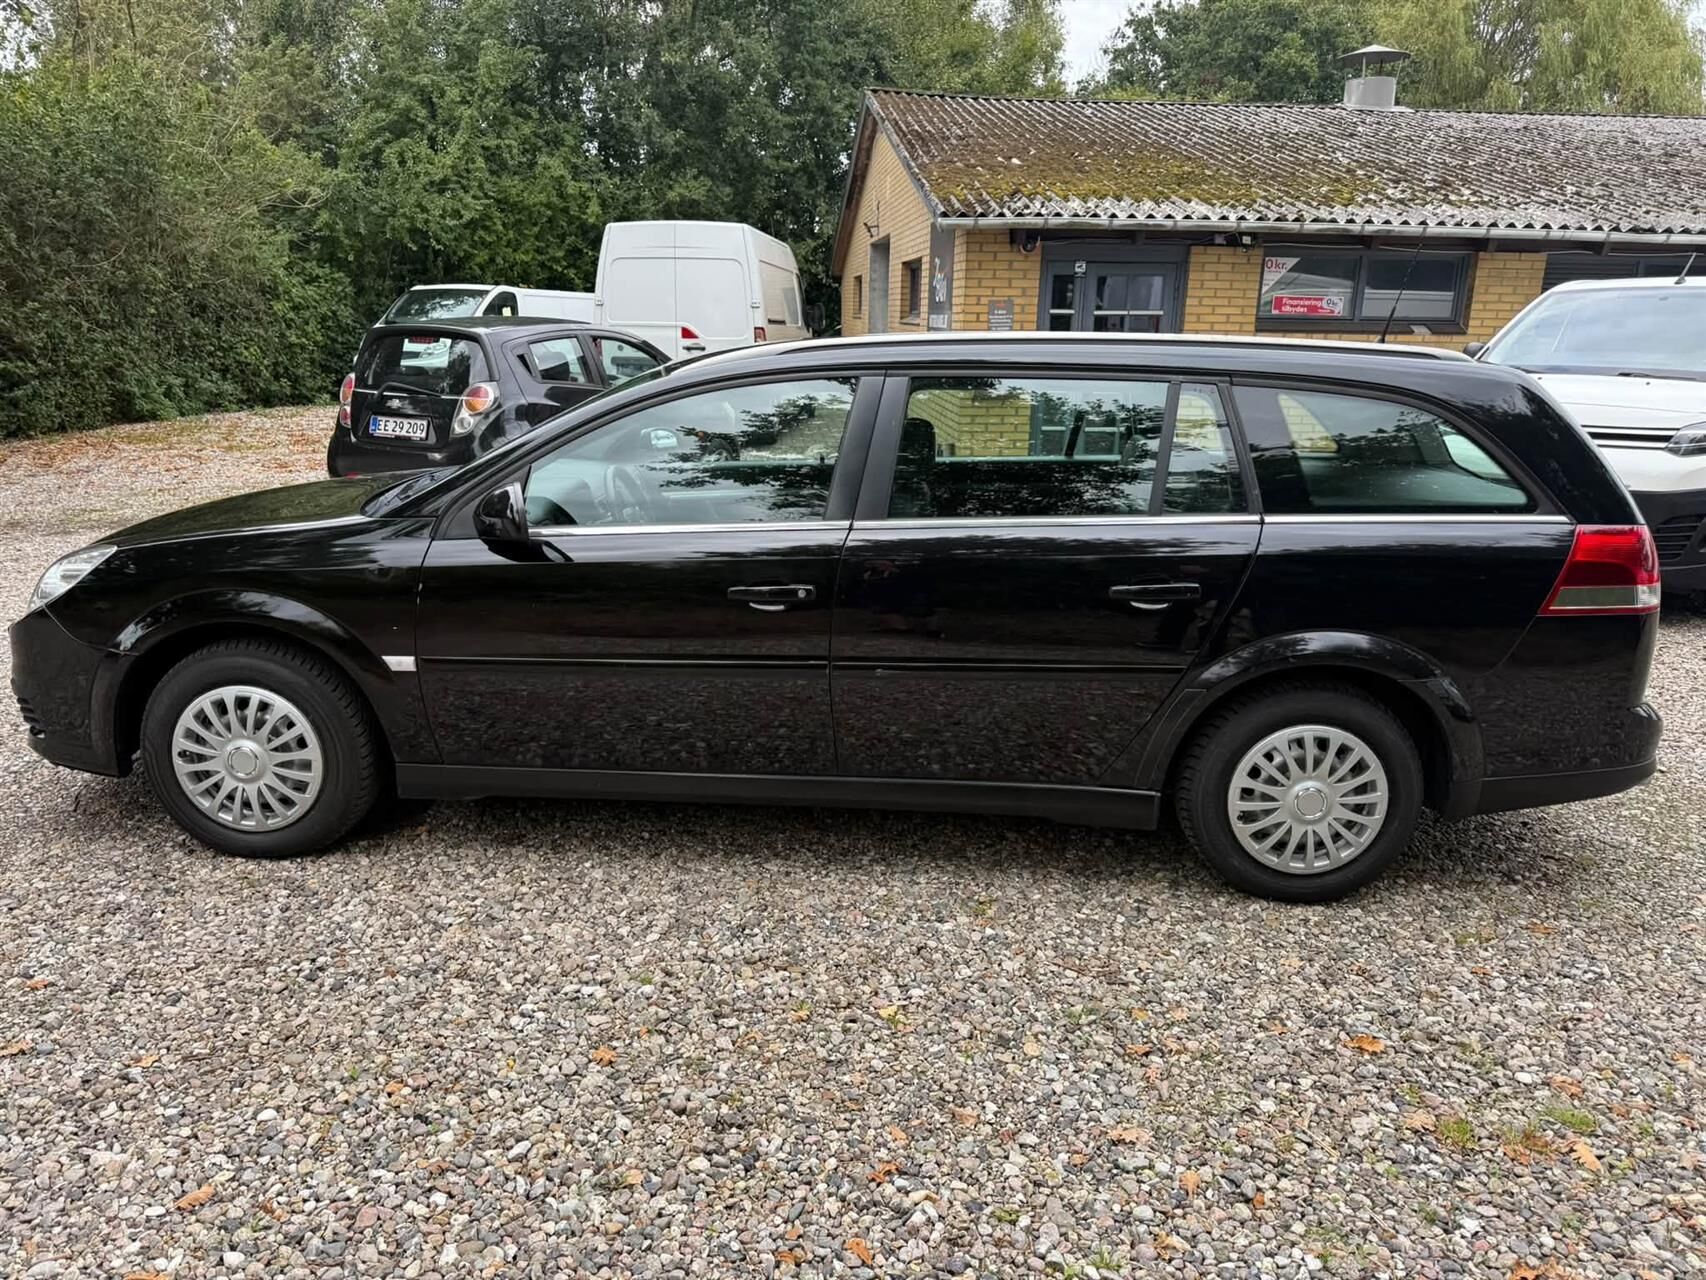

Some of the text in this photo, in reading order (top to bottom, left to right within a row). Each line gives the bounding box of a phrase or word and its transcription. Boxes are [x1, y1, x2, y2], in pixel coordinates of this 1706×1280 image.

[1282, 298, 1321, 307] Finansiering
[1282, 305, 1307, 313] tilbydes
[377, 419, 425, 435] EE 29 209
